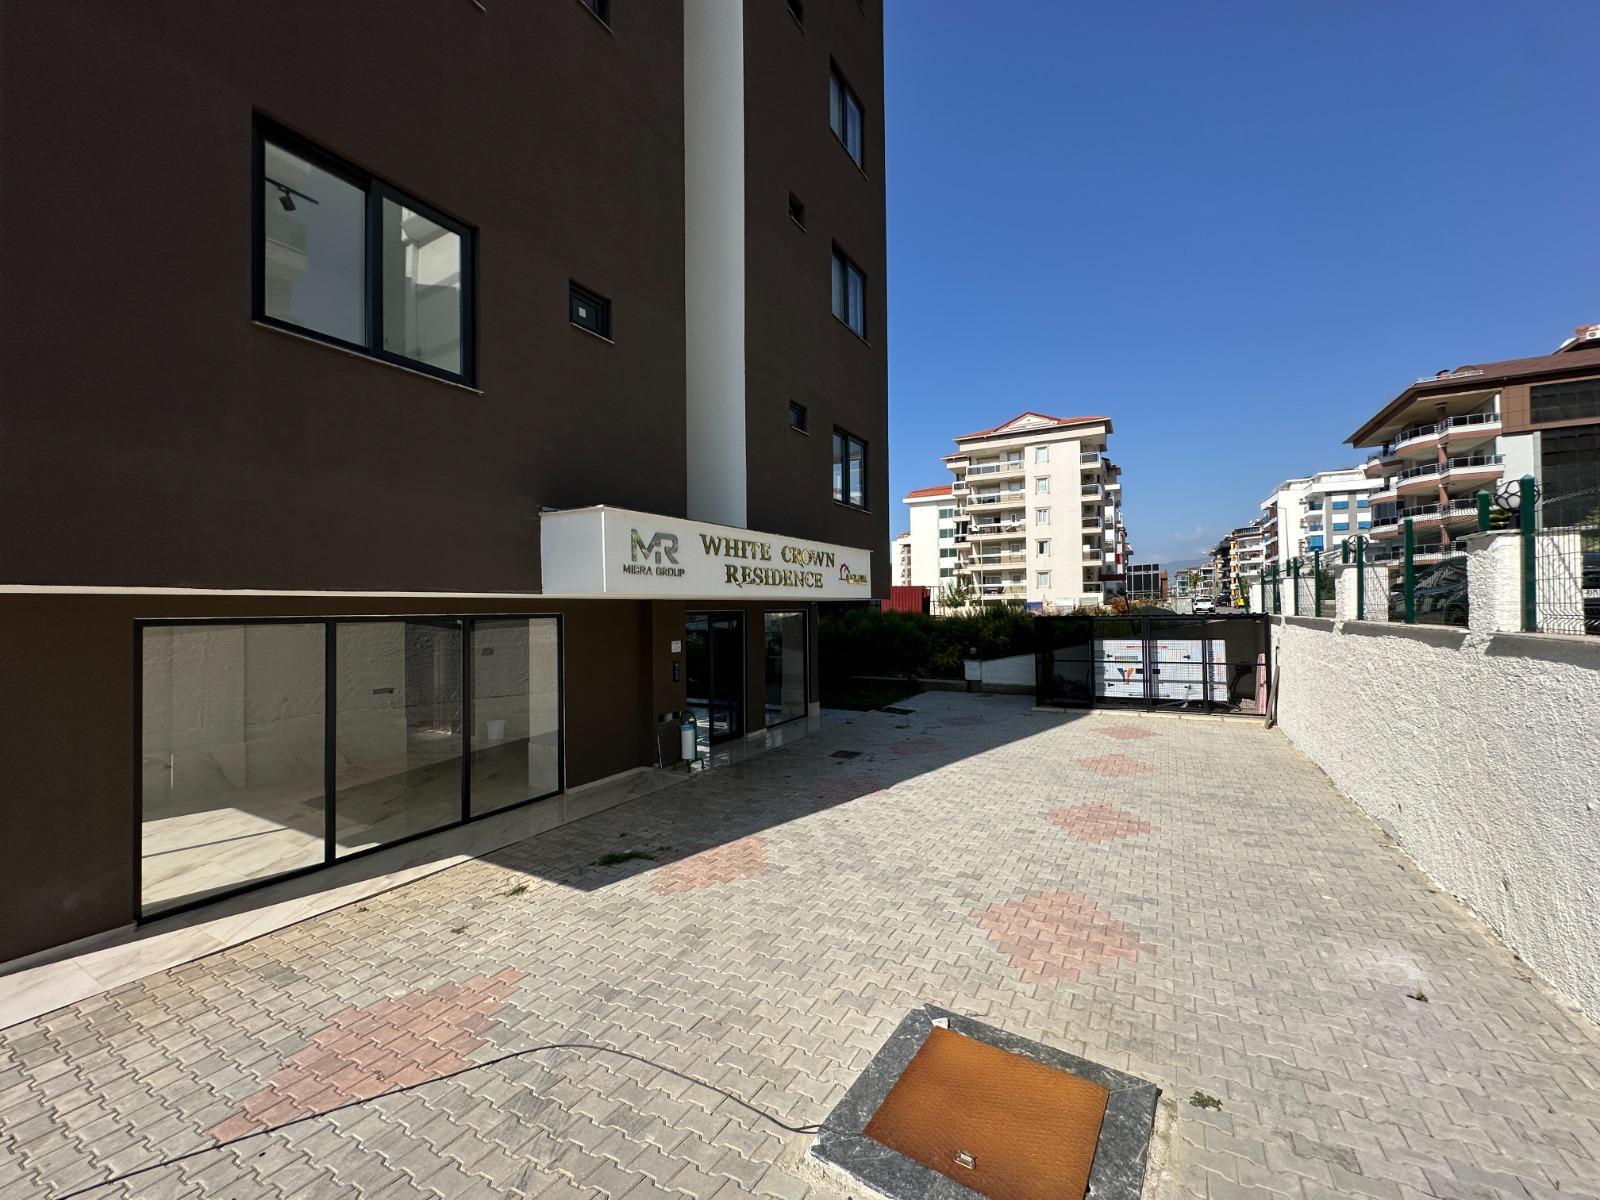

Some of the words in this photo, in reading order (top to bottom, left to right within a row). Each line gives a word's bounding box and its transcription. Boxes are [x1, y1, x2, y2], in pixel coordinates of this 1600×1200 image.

[699, 533, 772, 561] WHITE
[781, 545, 836, 568] CROWN
[655, 566, 685, 578] GROUP
[724, 564, 823, 588] RESIDENCE
